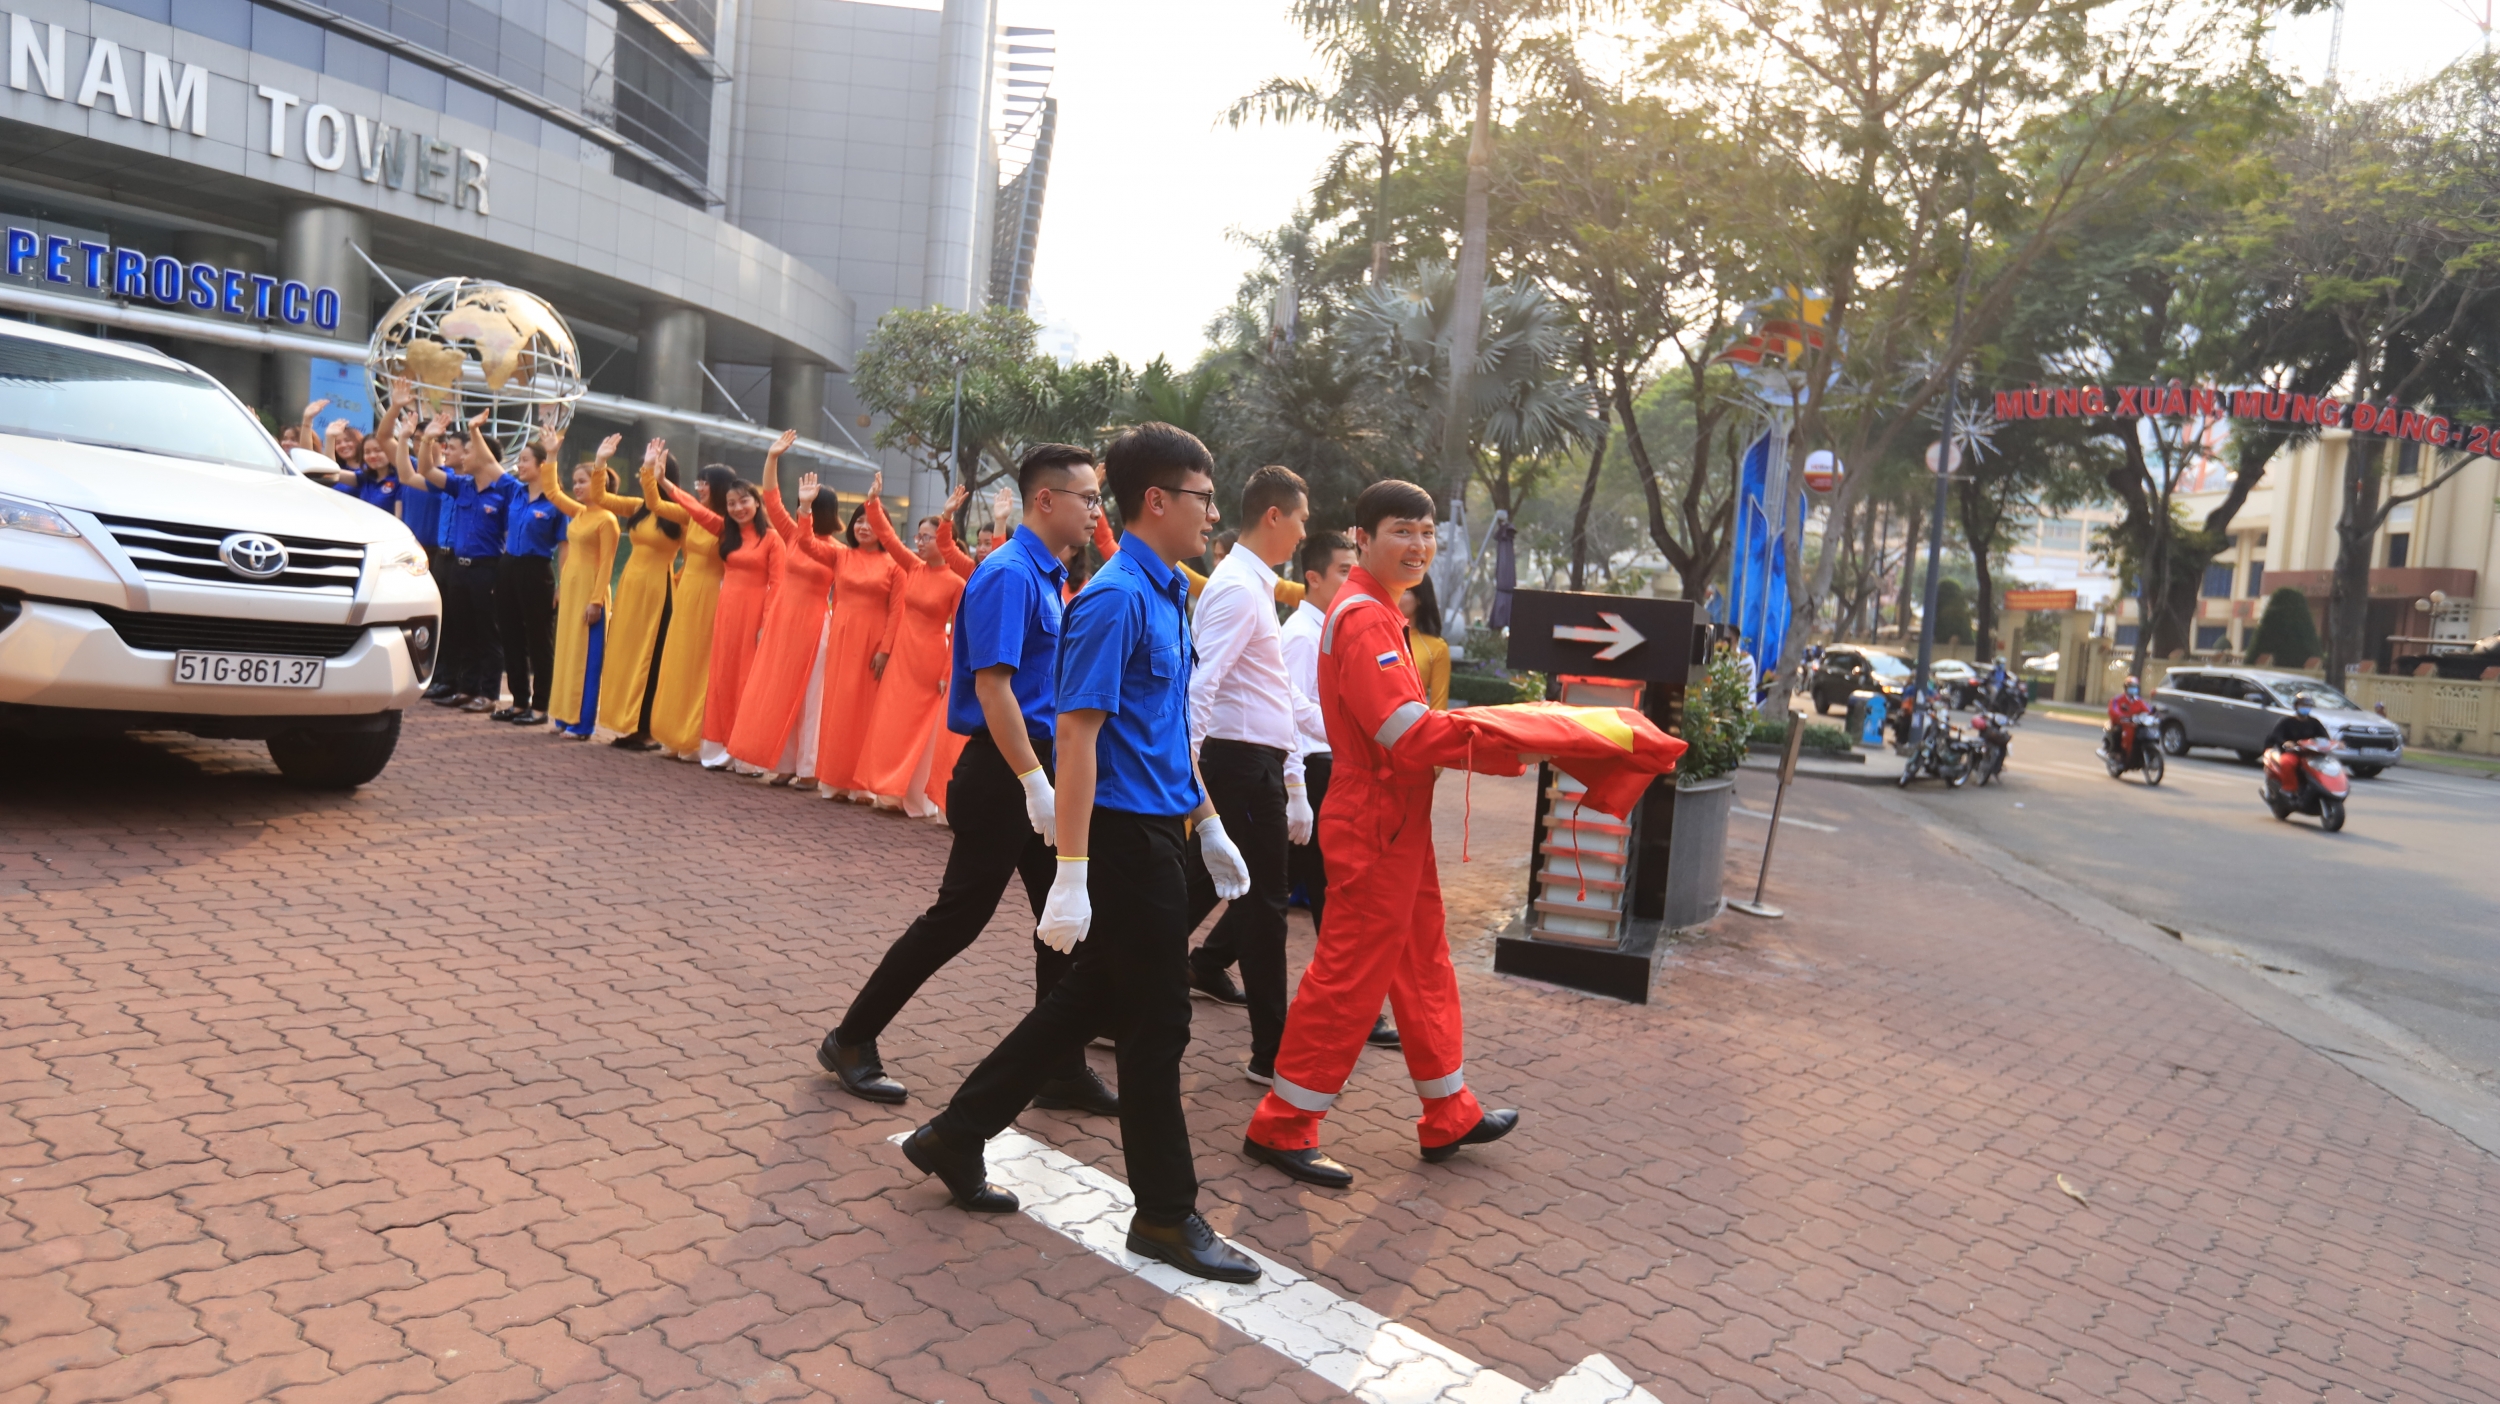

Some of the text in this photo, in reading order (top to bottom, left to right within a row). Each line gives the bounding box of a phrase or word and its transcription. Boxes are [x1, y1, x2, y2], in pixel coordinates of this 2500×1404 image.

[10, 13, 490, 215] NAM TOWER
[6, 226, 341, 331] PETROSETCO
[2114, 377, 2223, 421] XUÂN,
[180, 655, 319, 685] 51G-861.37
